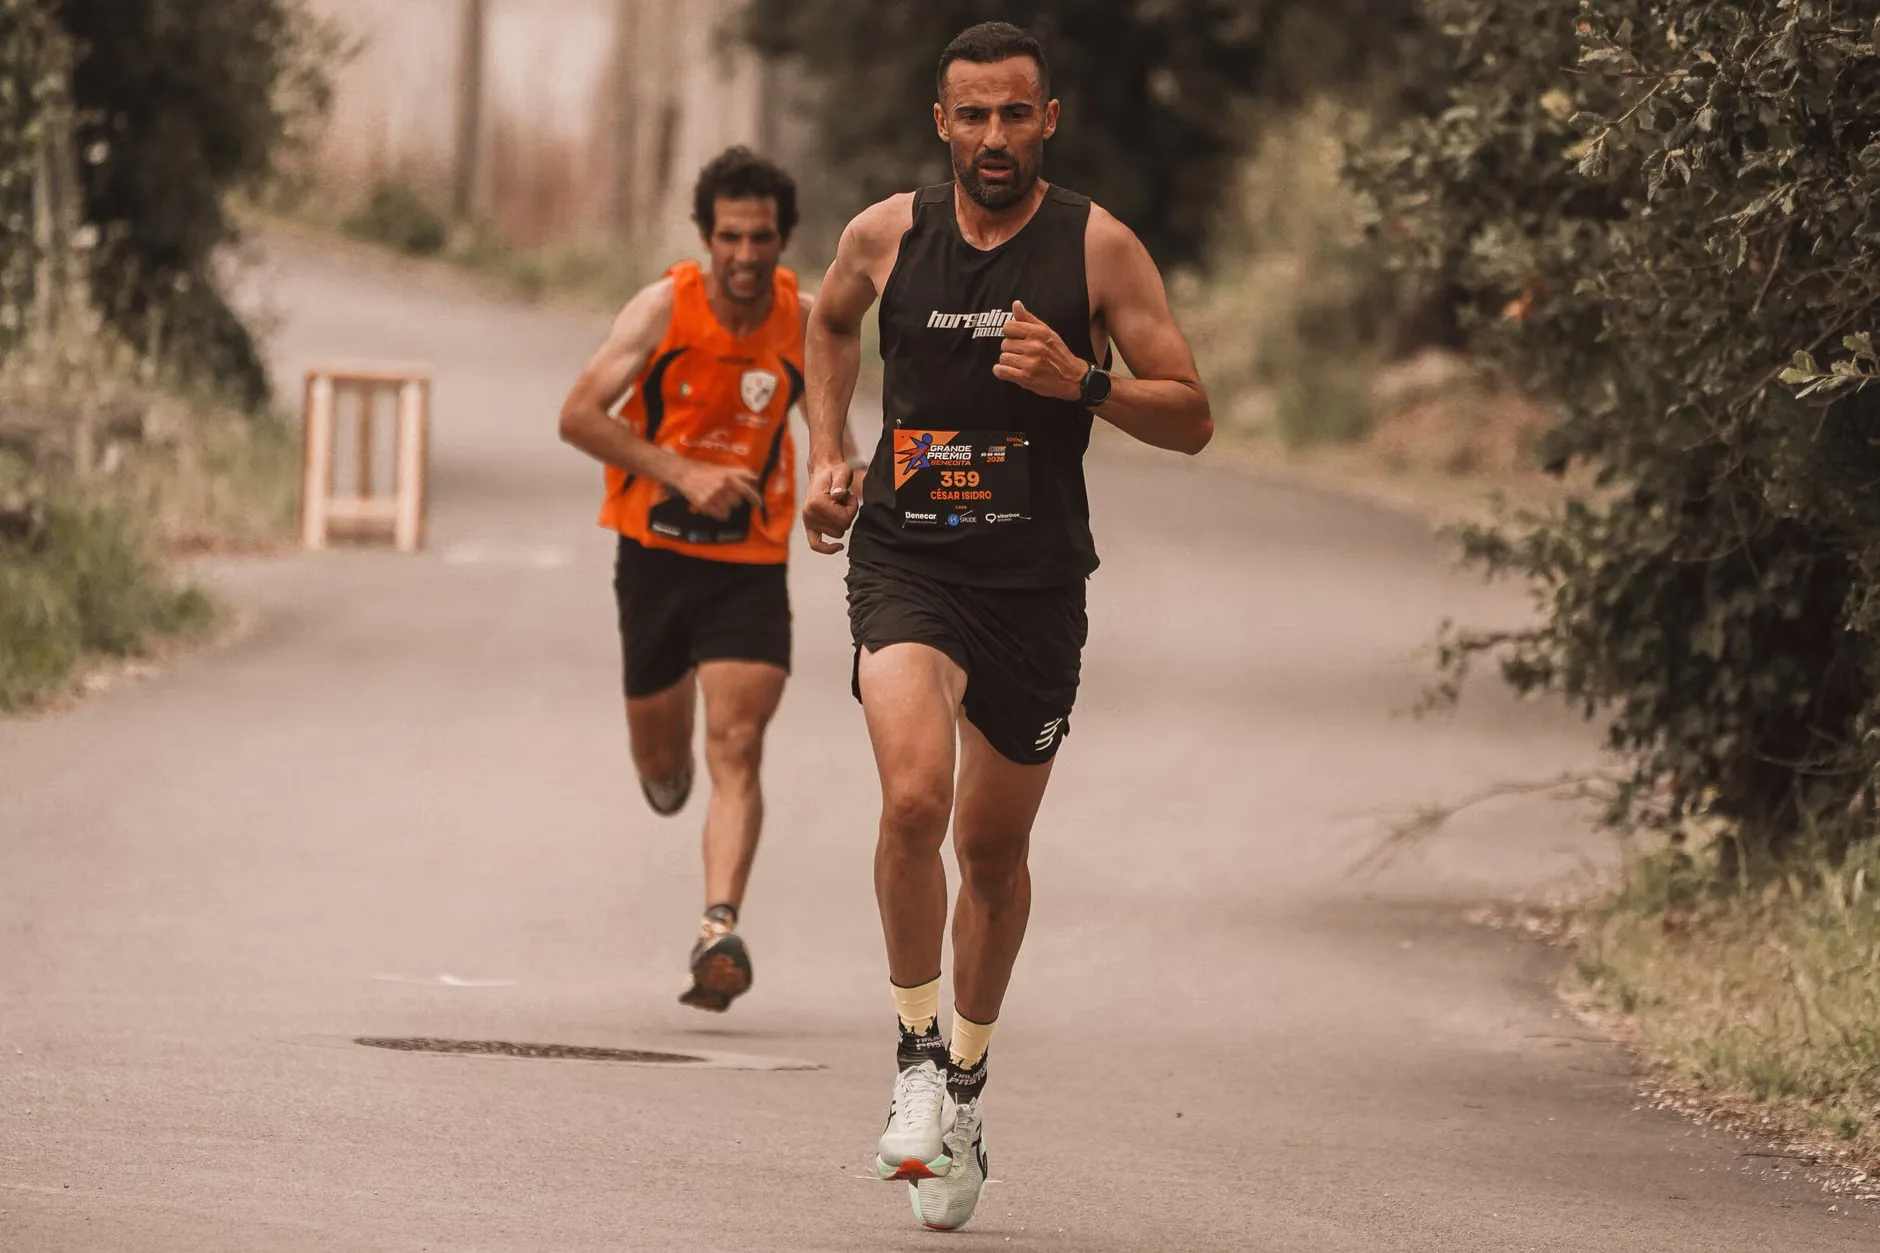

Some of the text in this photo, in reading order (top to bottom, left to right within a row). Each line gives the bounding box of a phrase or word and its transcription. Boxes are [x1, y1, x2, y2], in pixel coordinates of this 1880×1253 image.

[926, 309, 1015, 328] horselin
[972, 327, 1006, 339] powe
[927, 451, 972, 460] PRÉMIO
[940, 470, 980, 487] 359
[930, 488, 992, 500] CÉSAR ISIDRO
[905, 511, 937, 519] Benecar
